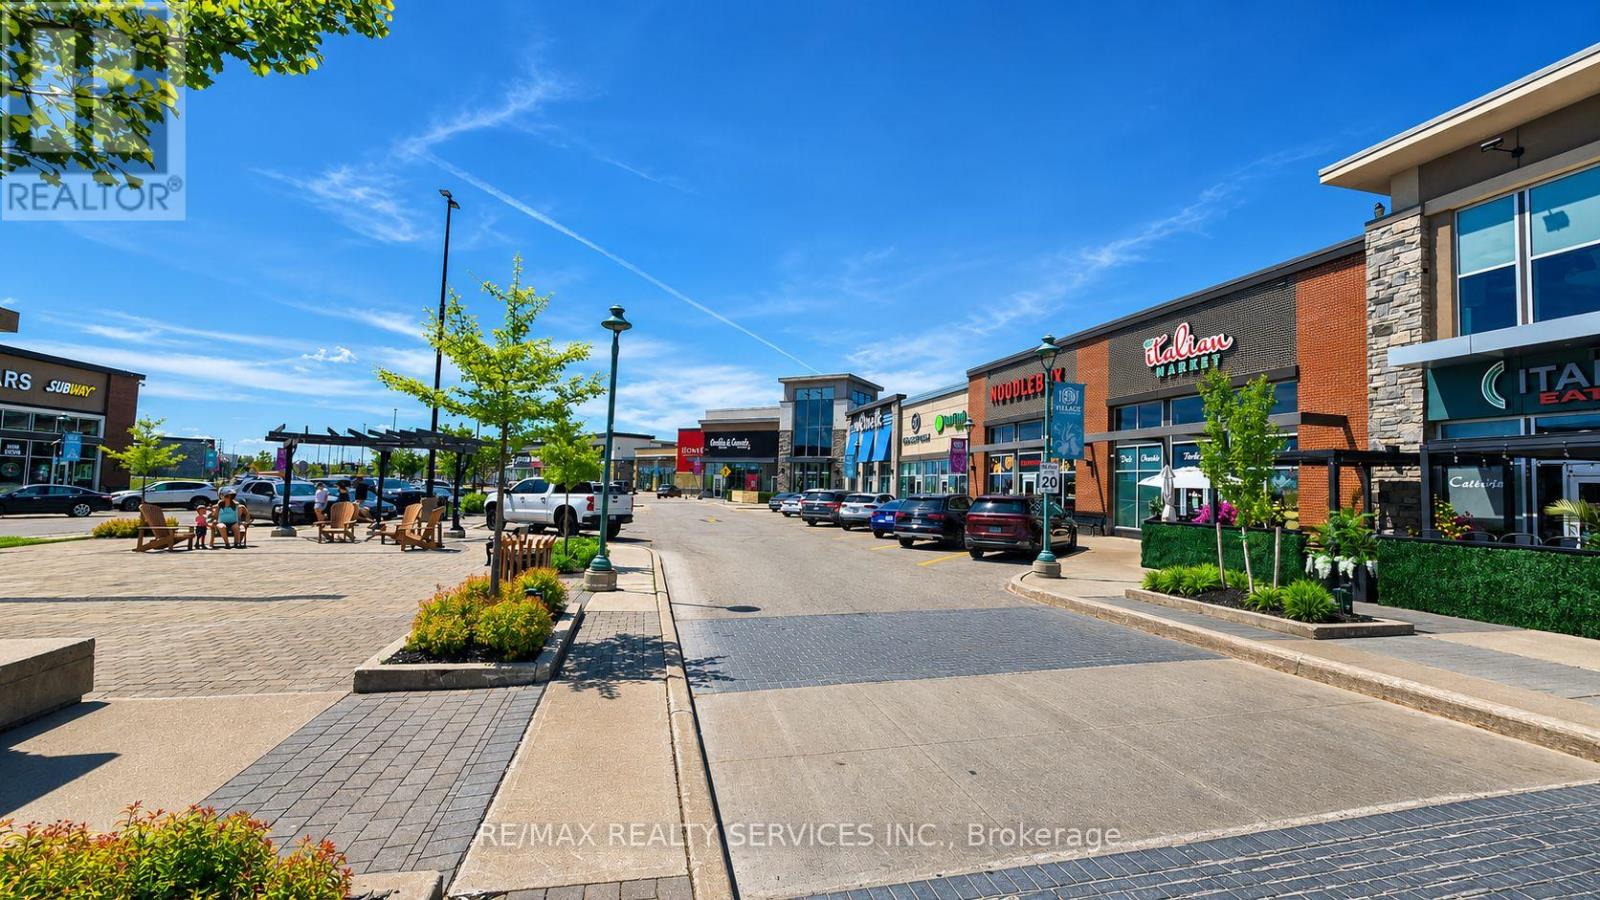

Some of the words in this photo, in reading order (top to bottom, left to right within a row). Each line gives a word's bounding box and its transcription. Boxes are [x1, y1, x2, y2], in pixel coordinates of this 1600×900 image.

[1155, 353, 1221, 378] MARKET
[0, 369, 32, 391] RS
[46, 379, 96, 397] SUBWAY
[989, 367, 1063, 401] NOODLEBX
[1056, 404, 1082, 413] VILLAGE
[1041, 475, 1058, 488] 20
